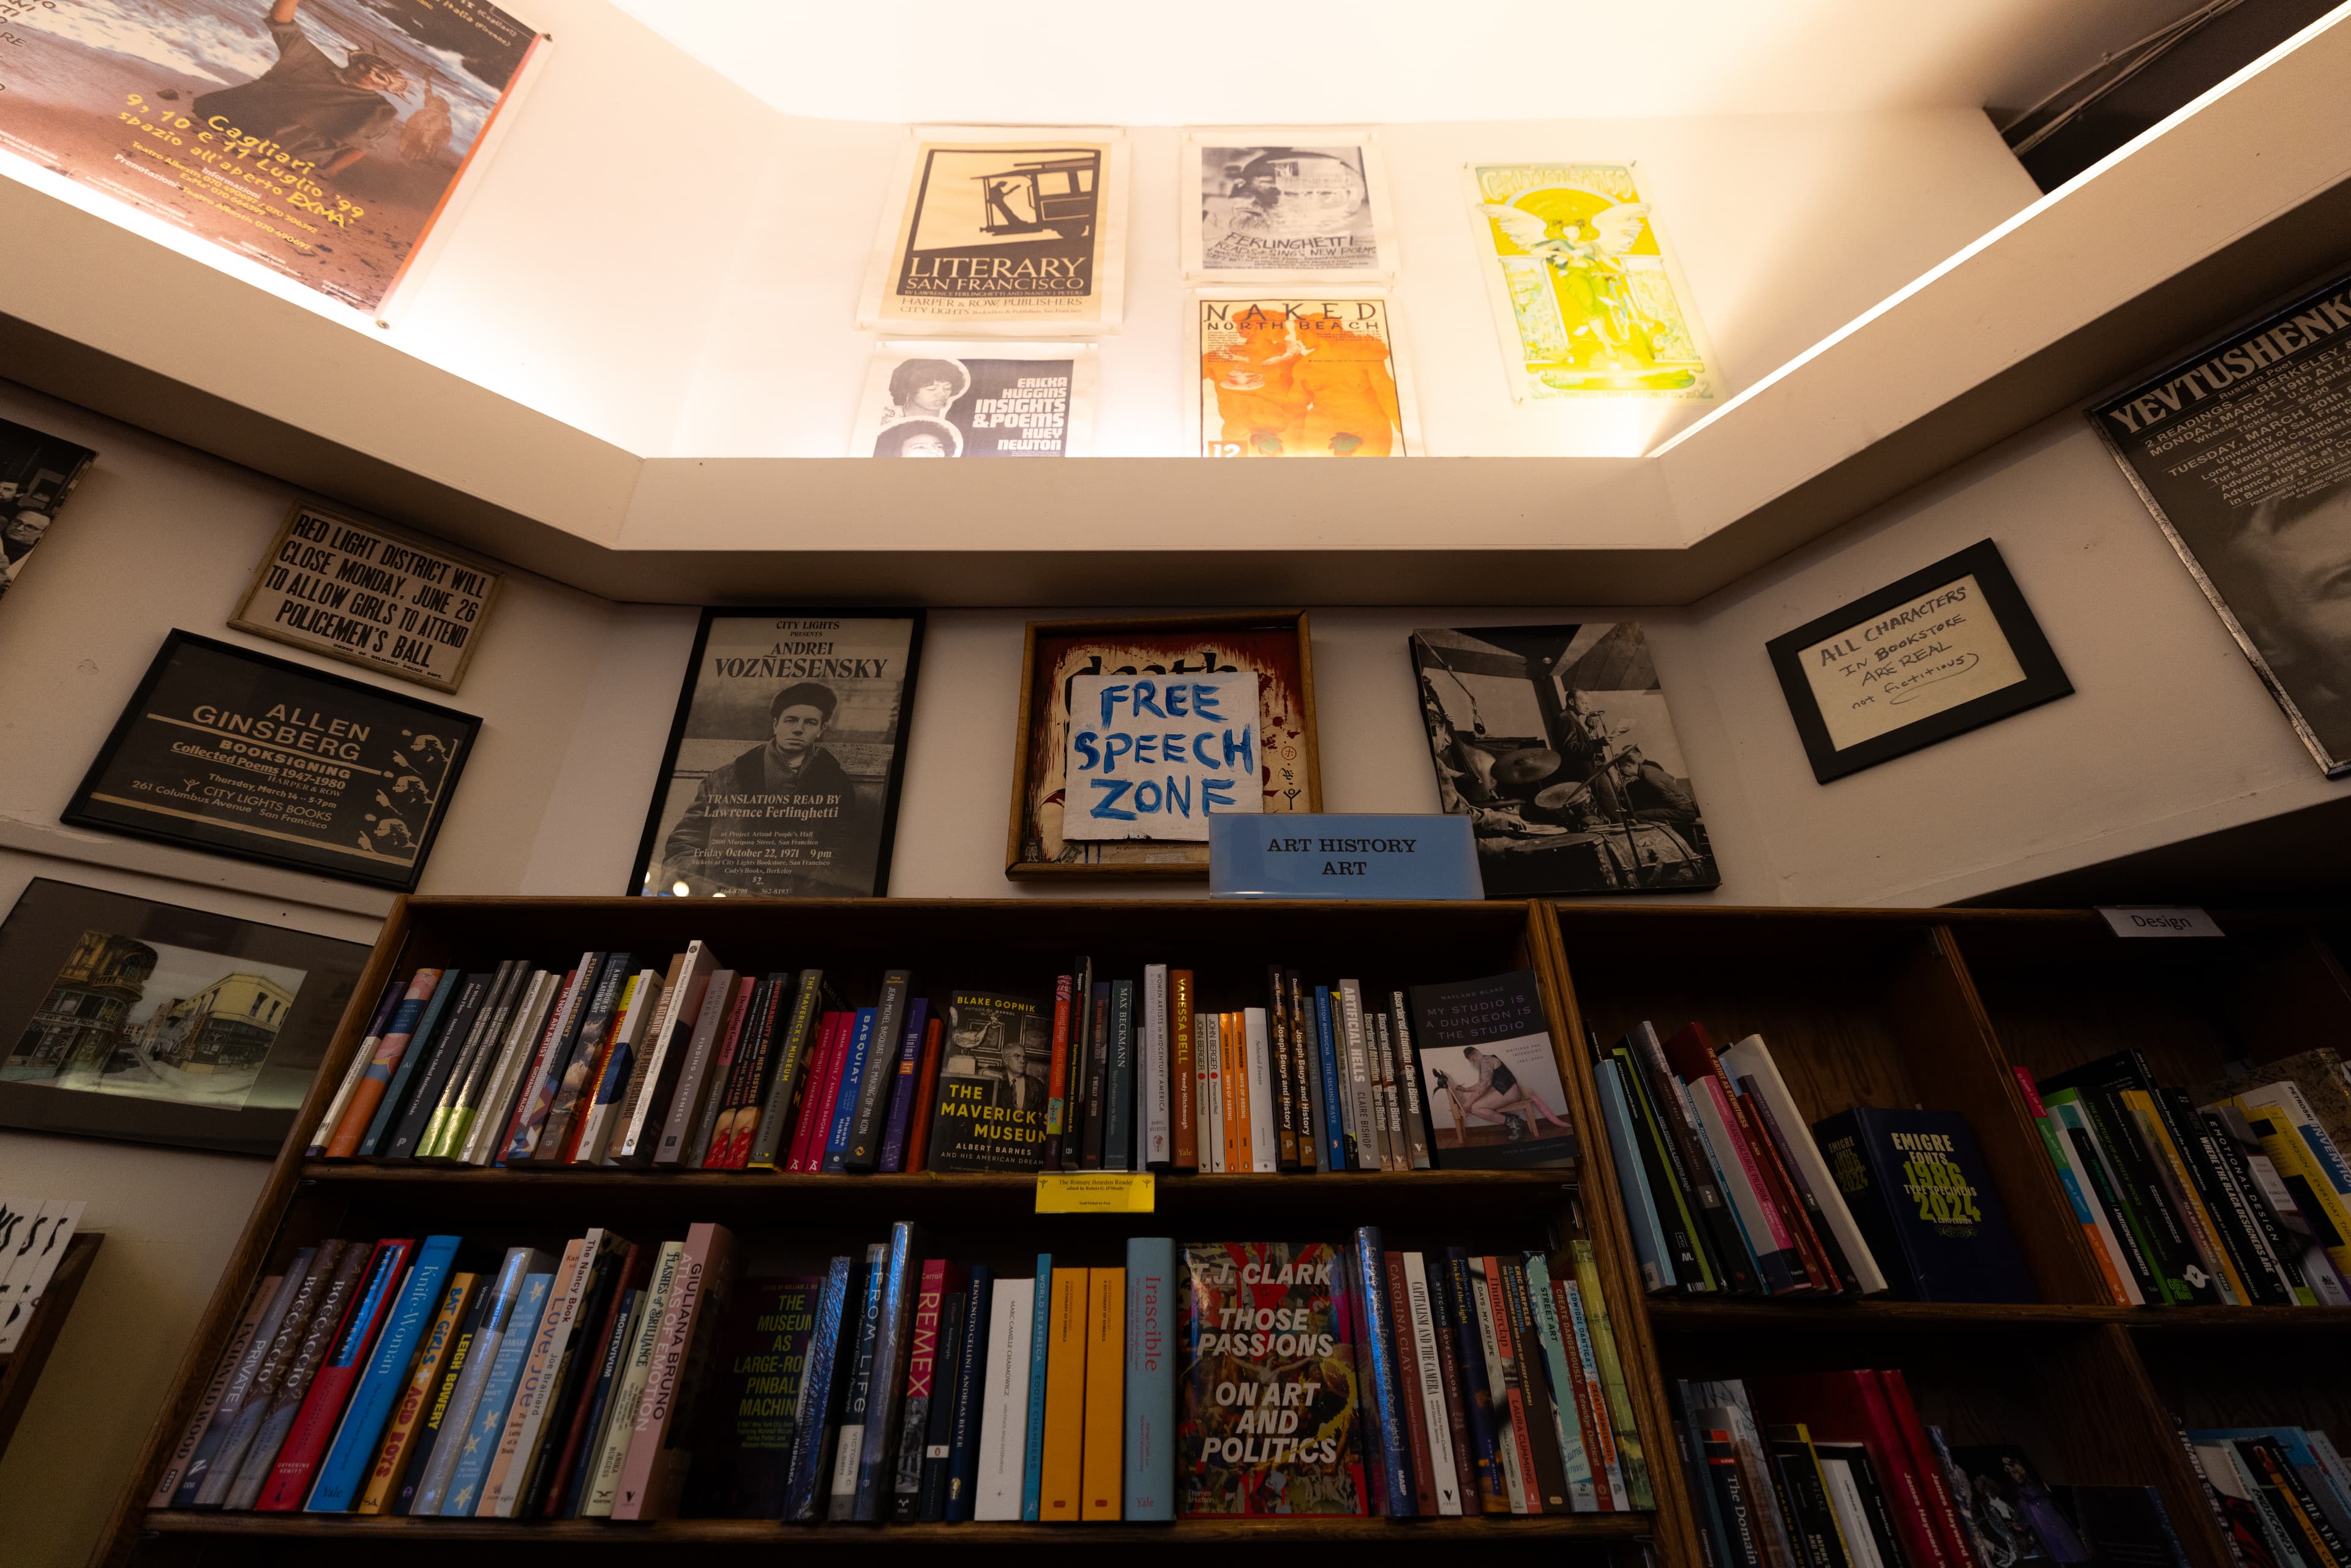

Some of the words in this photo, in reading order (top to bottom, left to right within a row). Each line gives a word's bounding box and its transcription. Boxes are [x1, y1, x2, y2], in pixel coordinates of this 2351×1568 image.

[118, 112, 182, 146] spazio
[160, 110, 191, 129] 10
[198, 131, 213, 143] e
[223, 141, 251, 159] 11
[257, 159, 323, 198] Luglio
[209, 116, 315, 174] Cagliari
[201, 167, 263, 200] Informazioni
[1224, 231, 1354, 250] FERLINGHETTI
[1341, 246, 1376, 255] POEMS
[909, 257, 1087, 278] LITERARY
[907, 277, 949, 290] SAN
[958, 278, 1084, 291] FRANCISCO
[902, 298, 954, 307] HARPER
[1004, 298, 1083, 306] PUBLISHERS
[932, 306, 970, 315] LIGHTS
[1203, 302, 1376, 323] NAKED
[1207, 321, 1284, 331] NORTH
[1299, 321, 1379, 330] BEACH
[2109, 287, 2351, 433] YEVTUSHENK
[1002, 388, 1067, 398] HUGGINS
[1017, 377, 1068, 388] ERICKA
[2157, 401, 2234, 441] READINGS
[2257, 348, 2339, 393] BERKELEY
[2219, 375, 2264, 400] Russian
[2266, 360, 2293, 376] Poet
[975, 398, 1066, 413] INSIGHTS
[2219, 392, 2278, 422] MARCH
[2297, 386, 2330, 405] $4.00
[1022, 428, 1063, 439] HUEY
[2244, 410, 2304, 441] MARCH
[997, 439, 1062, 450] NEWTON
[1212, 444, 1241, 457] 12
[292, 513, 330, 544] RED
[330, 526, 380, 560] LIGHT
[380, 543, 451, 585] DISTRICT
[450, 567, 486, 599] WILL
[279, 540, 336, 576] CLOSE
[335, 558, 407, 601] MONDAY,
[411, 584, 454, 615] JUNE
[454, 599, 479, 623] 26
[265, 565, 290, 591] TO
[286, 573, 349, 610] ALLOW
[349, 592, 398, 626] GIRLS
[398, 606, 420, 632] TO
[418, 613, 469, 649] ATTEND
[275, 599, 388, 653] POLICEMEN'S
[391, 636, 435, 669] BALL
[776, 621, 799, 629] CITY
[803, 621, 840, 629] LIGHTS
[1820, 638, 1862, 667] ALL
[1863, 586, 1968, 642] CHARACTERS
[332, 643, 354, 653] ORDER
[370, 655, 399, 667] BELMONT
[403, 664, 423, 674] POLICE
[771, 642, 834, 656] ANDREI
[1839, 659, 1868, 677] IN
[1875, 613, 1967, 662] BOOKSTORE
[1861, 662, 1897, 686] ARE
[1899, 641, 1952, 667] REAL
[1852, 696, 1876, 710] not
[1884, 656, 1965, 694] fictitious
[1100, 680, 1228, 729] FREE
[192, 705, 362, 762] GINSBERG
[265, 702, 372, 742] ALLEN
[219, 738, 353, 780] BOOKSIGNING
[1074, 722, 1254, 775] SPEECH
[171, 740, 238, 768] Collected
[235, 755, 280, 776] Poems
[280, 767, 347, 790] 1947-1980
[131, 779, 153, 792] 261
[154, 783, 209, 805] Columbus
[210, 797, 253, 813] Avenue
[259, 808, 279, 819] San
[279, 812, 328, 830] Francisco
[203, 786, 241, 806] CITY
[242, 792, 285, 815] LIGHTS
[285, 803, 332, 822] BOOKS
[704, 806, 763, 818] Lawrence
[765, 806, 839, 821] Ferlinghetti
[707, 795, 790, 805] TRANSLATIONS
[793, 795, 823, 805] READ
[827, 795, 842, 804] BY
[1267, 838, 1314, 853] ART
[1319, 838, 1417, 853] HISTORY
[1322, 861, 1367, 876] ART
[2131, 914, 2193, 933] Design
[957, 996, 992, 1007] BLAKE
[994, 999, 1037, 1013] GOPNIK
[1177, 978, 1188, 1030] VANESSA
[1343, 987, 1363, 1046] ARTIFICIAL
[1427, 1007, 1445, 1018] MY
[1451, 999, 1504, 1015] STUDIO
[1510, 994, 1524, 1005] IS
[1440, 1010, 1511, 1028] DUNGEON
[1518, 1006, 1532, 1016] IS
[1117, 1011, 1127, 1068] BECKMANN
[1437, 1030, 1464, 1040] THE
[1470, 1021, 1524, 1038] STUDIO
[849, 1015, 872, 1086] BASQUIAT
[1178, 1033, 1188, 1064] BELL
[1350, 1049, 1365, 1083] HELLS
[949, 1084, 984, 1101] THE
[955, 1141, 991, 1153] ALBERT
[996, 1146, 1032, 1157] BARNES
[1891, 1132, 1955, 1152] EMIGRE
[1908, 1151, 1949, 1165] FONTS
[1903, 1160, 1968, 1189] 1986
[1913, 1194, 1982, 1223] 2024
[583, 1239, 596, 1258] The
[570, 1261, 589, 1294] Nancy
[1191, 1263, 1235, 1285] T.J.
[1243, 1263, 1333, 1285] CLARK
[561, 1297, 579, 1324] Book
[671, 1262, 703, 1347] GIULIANA
[1218, 1308, 1310, 1330] THOSE
[1489, 1274, 1510, 1348] Thunderclap
[1540, 1286, 1556, 1322] STREET
[1548, 1324, 1559, 1343] ART
[1144, 1276, 1162, 1372] Irascible
[450, 1332, 473, 1370] LEIGH
[906, 1291, 940, 1397] REMEX
[1196, 1334, 1334, 1357] PASSIONS
[651, 1352, 682, 1420] BRUNO
[1215, 1382, 1264, 1406] ON
[1264, 1382, 1321, 1406] ART
[428, 1372, 459, 1431] BOWERY
[1235, 1410, 1299, 1435] AND
[1200, 1437, 1338, 1463] POLITICS
